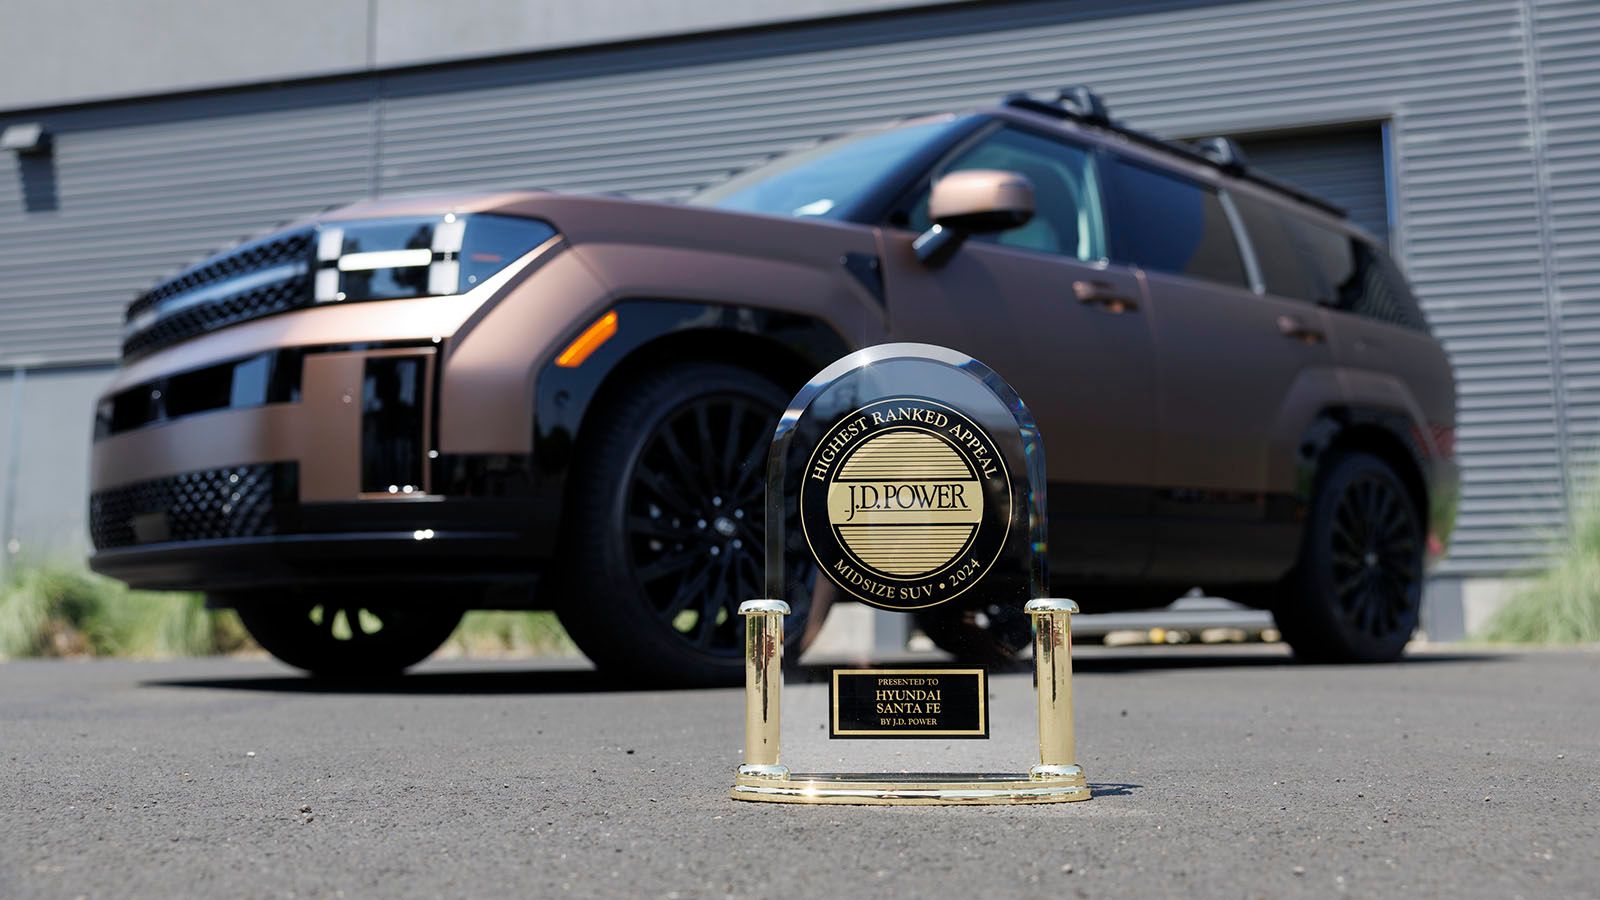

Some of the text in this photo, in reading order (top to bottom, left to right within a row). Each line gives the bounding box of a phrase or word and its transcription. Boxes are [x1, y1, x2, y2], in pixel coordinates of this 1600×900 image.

[811, 407, 998, 482] HIGHEST RANKED APPEAL
[833, 558, 981, 599] MIDSIZE SUV 2024
[878, 678, 939, 686] PRESENTED TO
[876, 690, 941, 700] HYUNDAI
[876, 703, 941, 713] SANTA FE
[892, 718, 906, 726] J.D.
